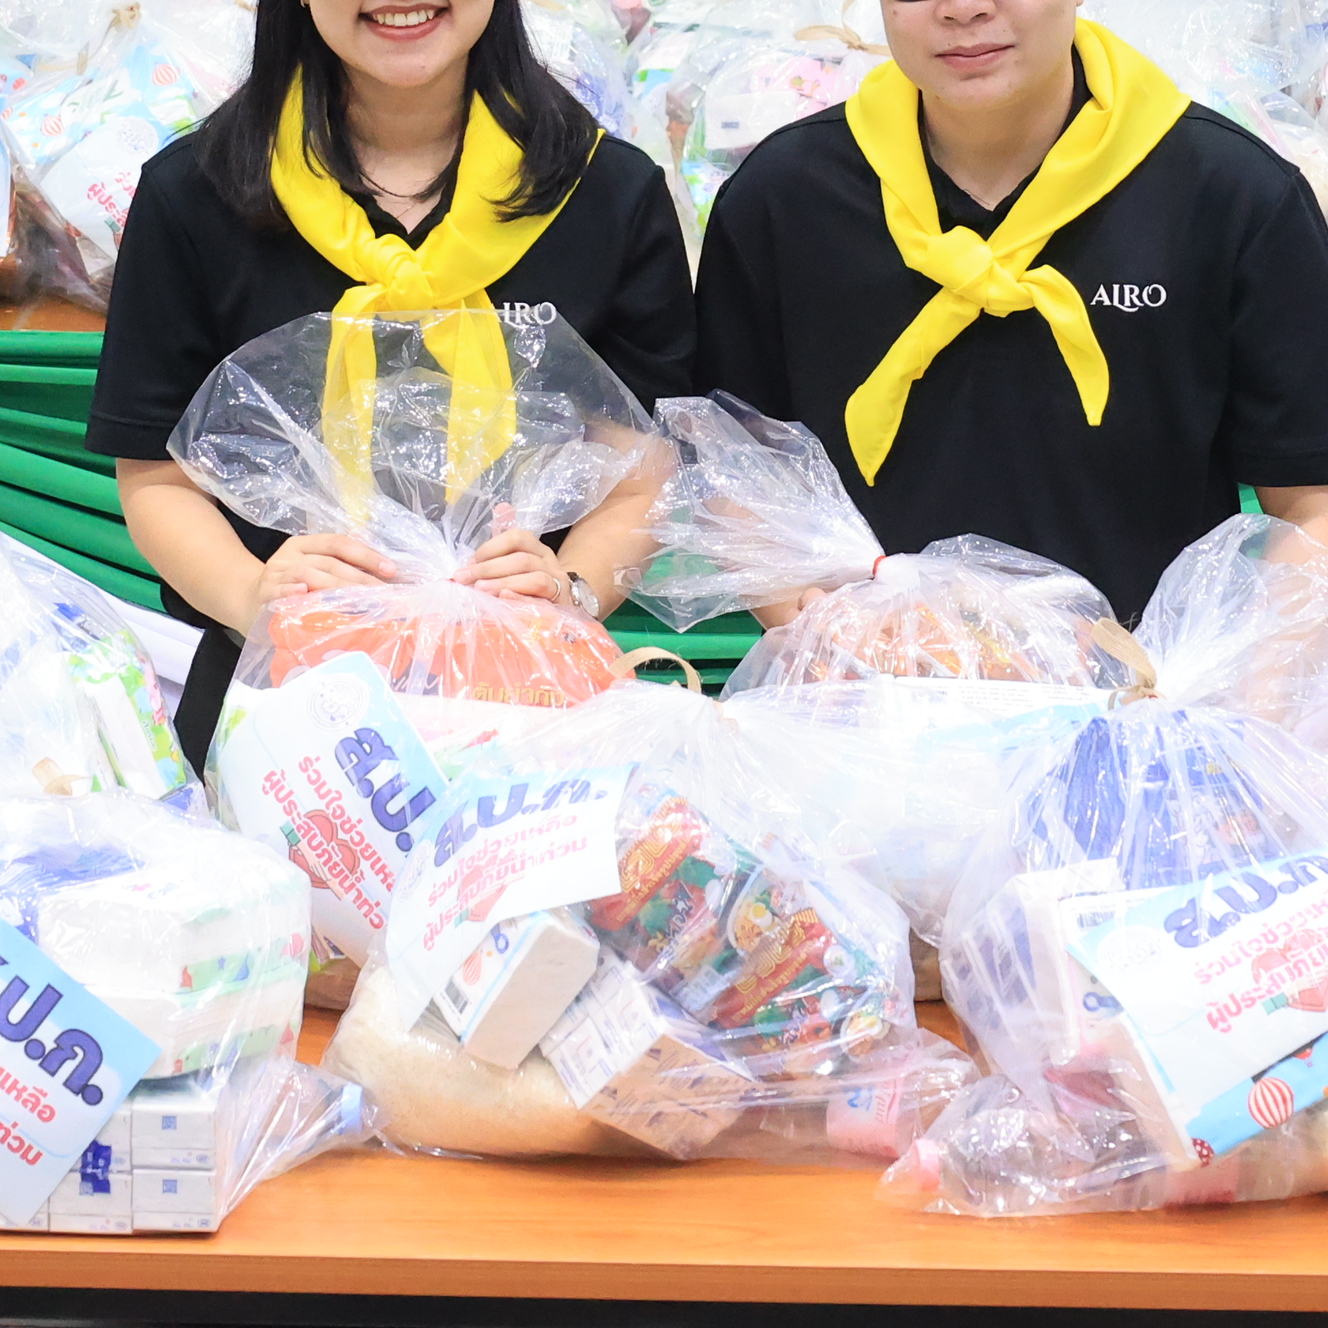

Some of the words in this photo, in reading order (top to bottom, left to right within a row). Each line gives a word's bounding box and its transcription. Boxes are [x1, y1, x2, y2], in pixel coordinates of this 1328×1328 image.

[496, 301, 557, 329] LRO
[262, 768, 387, 930] ผู้ประสบภัยน้ำท่ว
[298, 754, 397, 893] ร่วมใจช่วยเห
[335, 726, 437, 853] ส.ป.
[433, 771, 608, 867] ส.ป.ก.
